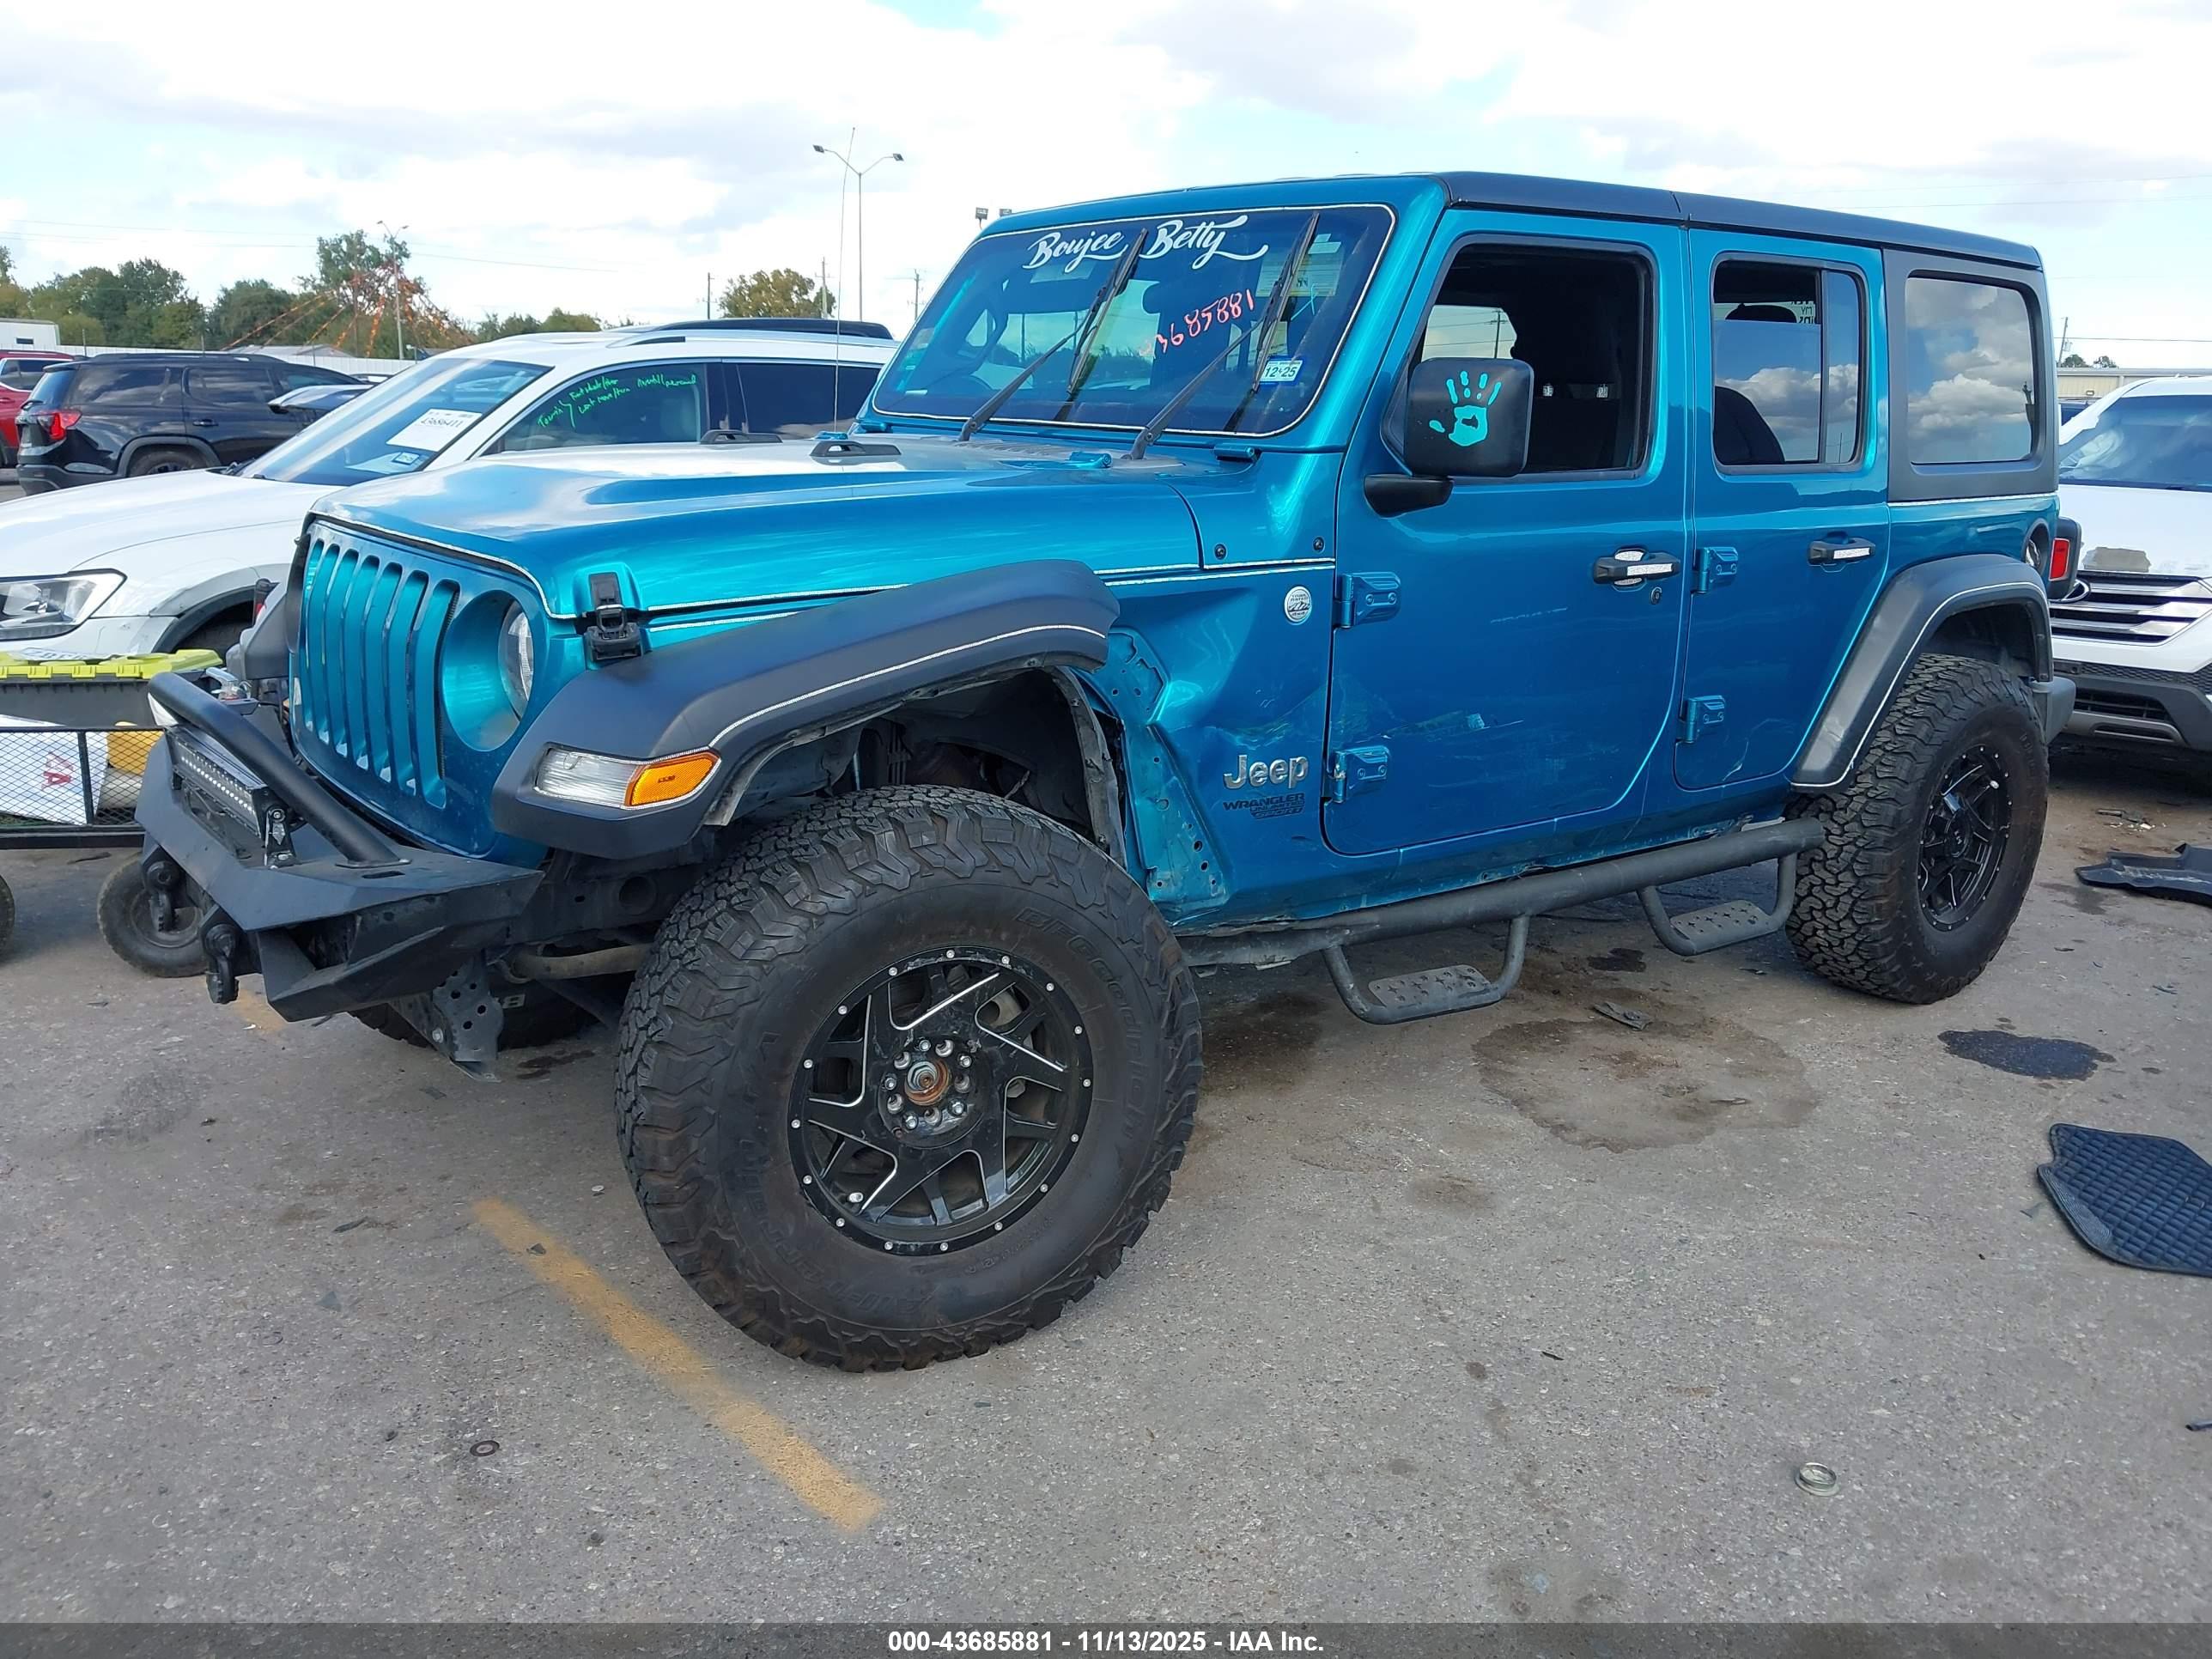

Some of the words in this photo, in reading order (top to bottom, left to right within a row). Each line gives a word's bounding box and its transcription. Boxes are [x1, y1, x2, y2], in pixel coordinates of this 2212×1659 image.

[1023, 232, 1128, 273] Boujee
[1139, 215, 1268, 269] Betty
[1224, 755, 1309, 789] Jeep
[1223, 793, 1305, 811] WRANGLER
